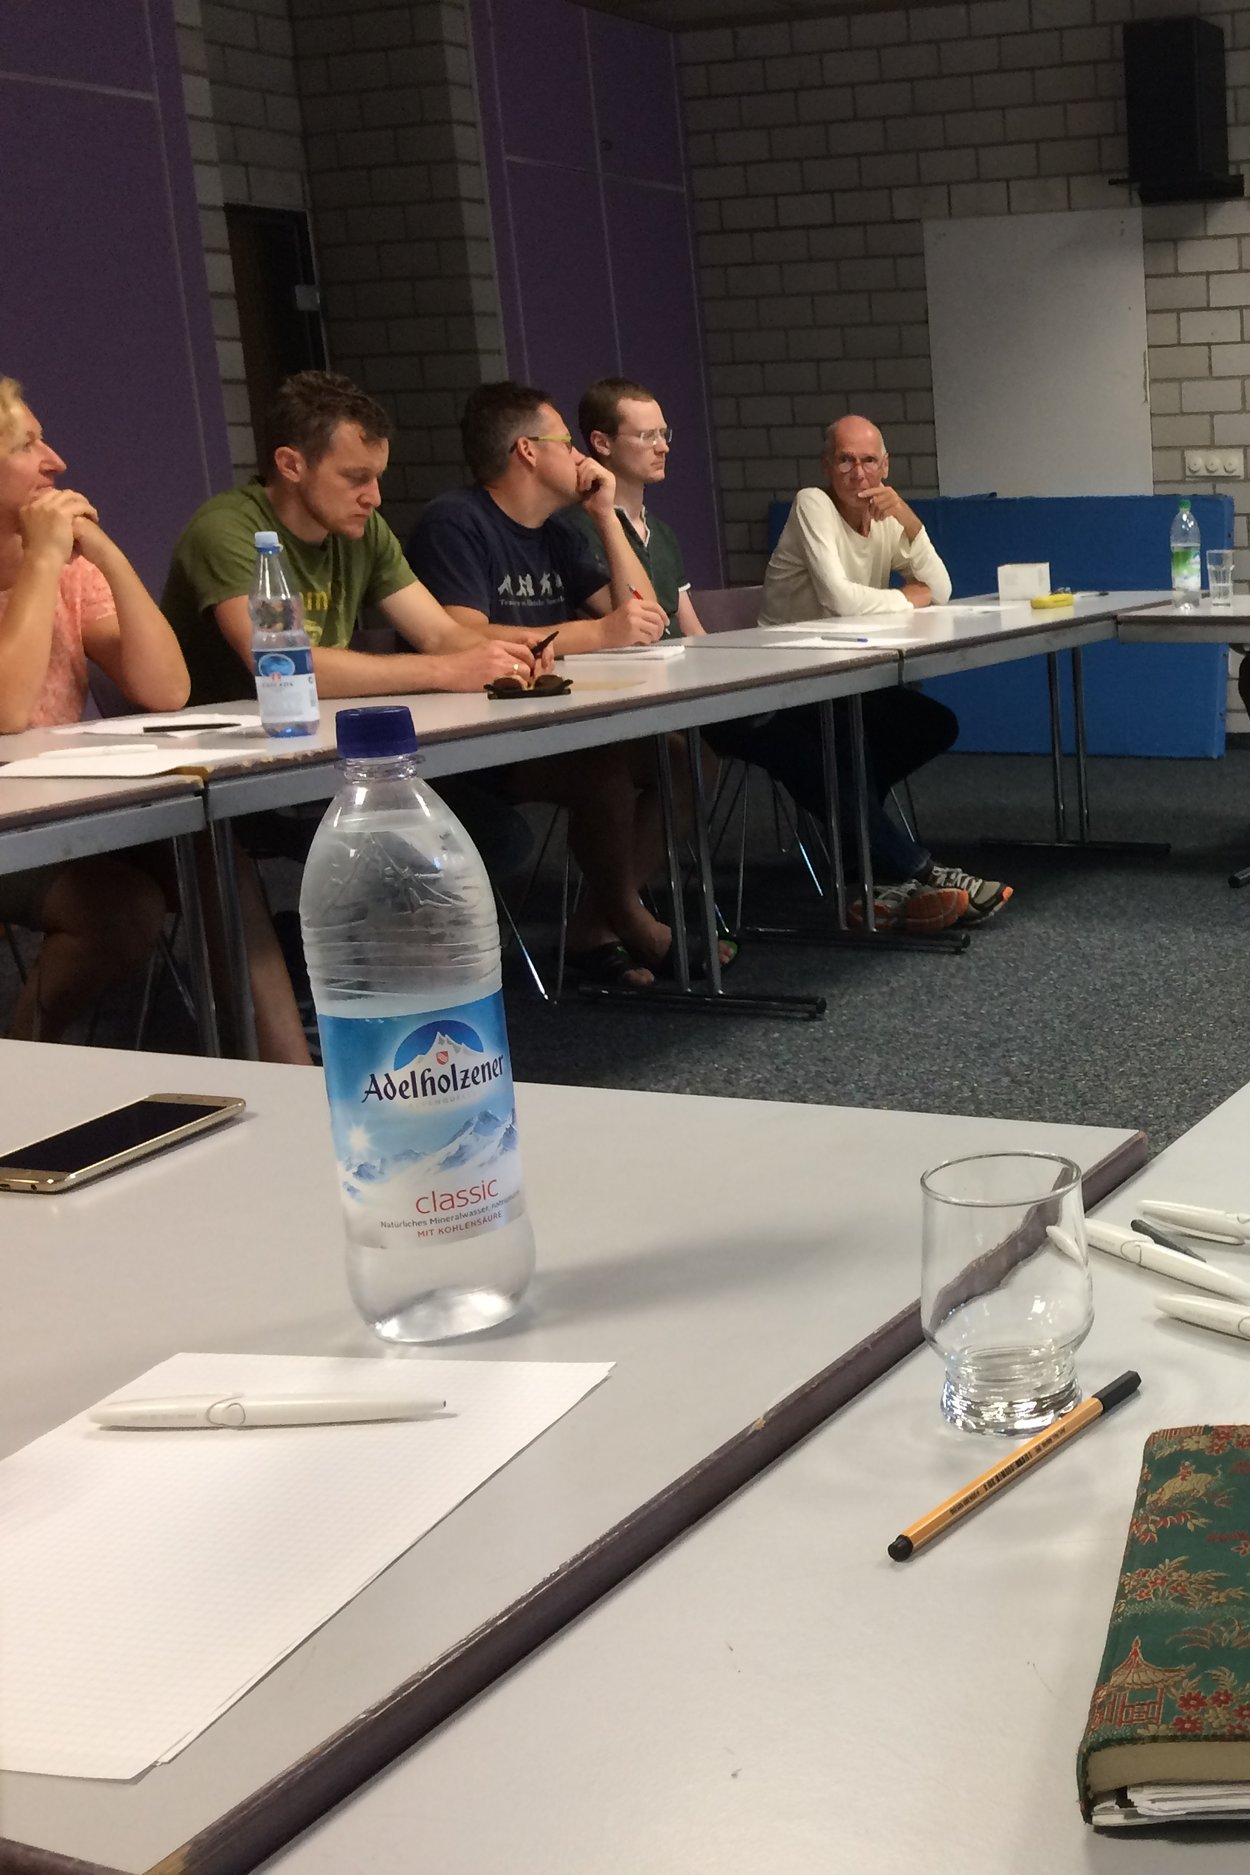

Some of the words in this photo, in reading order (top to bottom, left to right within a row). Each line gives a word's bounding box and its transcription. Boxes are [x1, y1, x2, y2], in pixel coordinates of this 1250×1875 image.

[361, 1052, 504, 1104] Adelholzener
[380, 1219, 428, 1229] Natürliches
[417, 1227, 434, 1238] MIT
[438, 1210, 503, 1236] KOHLENSÄURE
